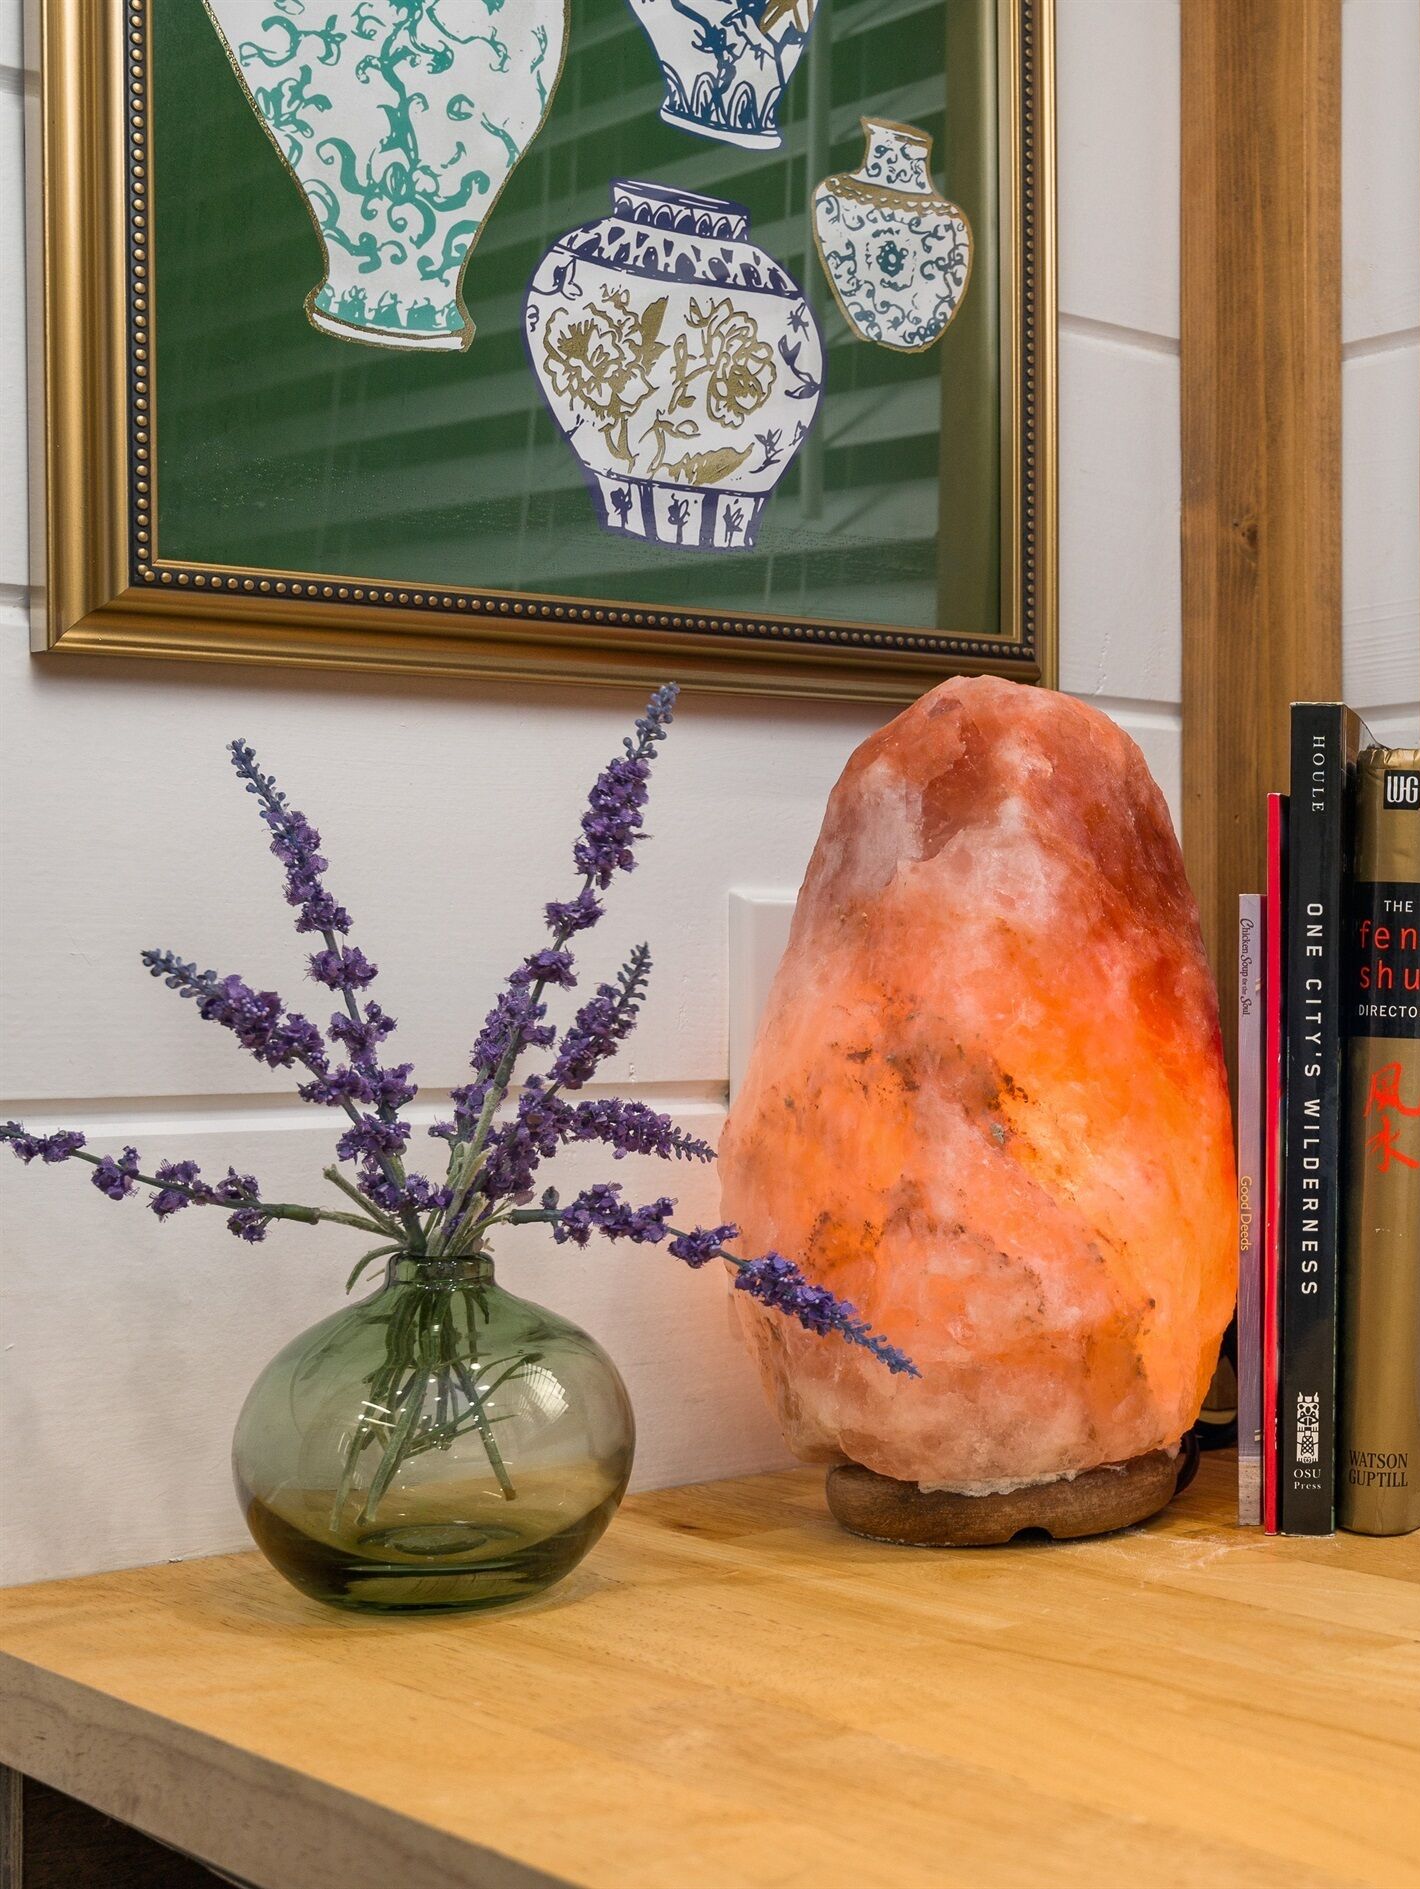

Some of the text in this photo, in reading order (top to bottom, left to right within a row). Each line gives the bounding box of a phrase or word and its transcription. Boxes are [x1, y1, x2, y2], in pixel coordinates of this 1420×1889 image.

[1312, 736, 1325, 811] HOULE
[1384, 901, 1413, 913] THE
[1240, 918, 1254, 953] Chicken
[1240, 954, 1252, 977] Soup
[1301, 903, 1323, 1295] ONE CITY'S WILDERNESS
[1240, 1176, 1252, 1251] Good Deeds
[1350, 1451, 1408, 1469] WATSON
[1294, 1469, 1321, 1478] OSU
[1349, 1471, 1408, 1487] GUPTILL
[1294, 1482, 1321, 1490] Press
